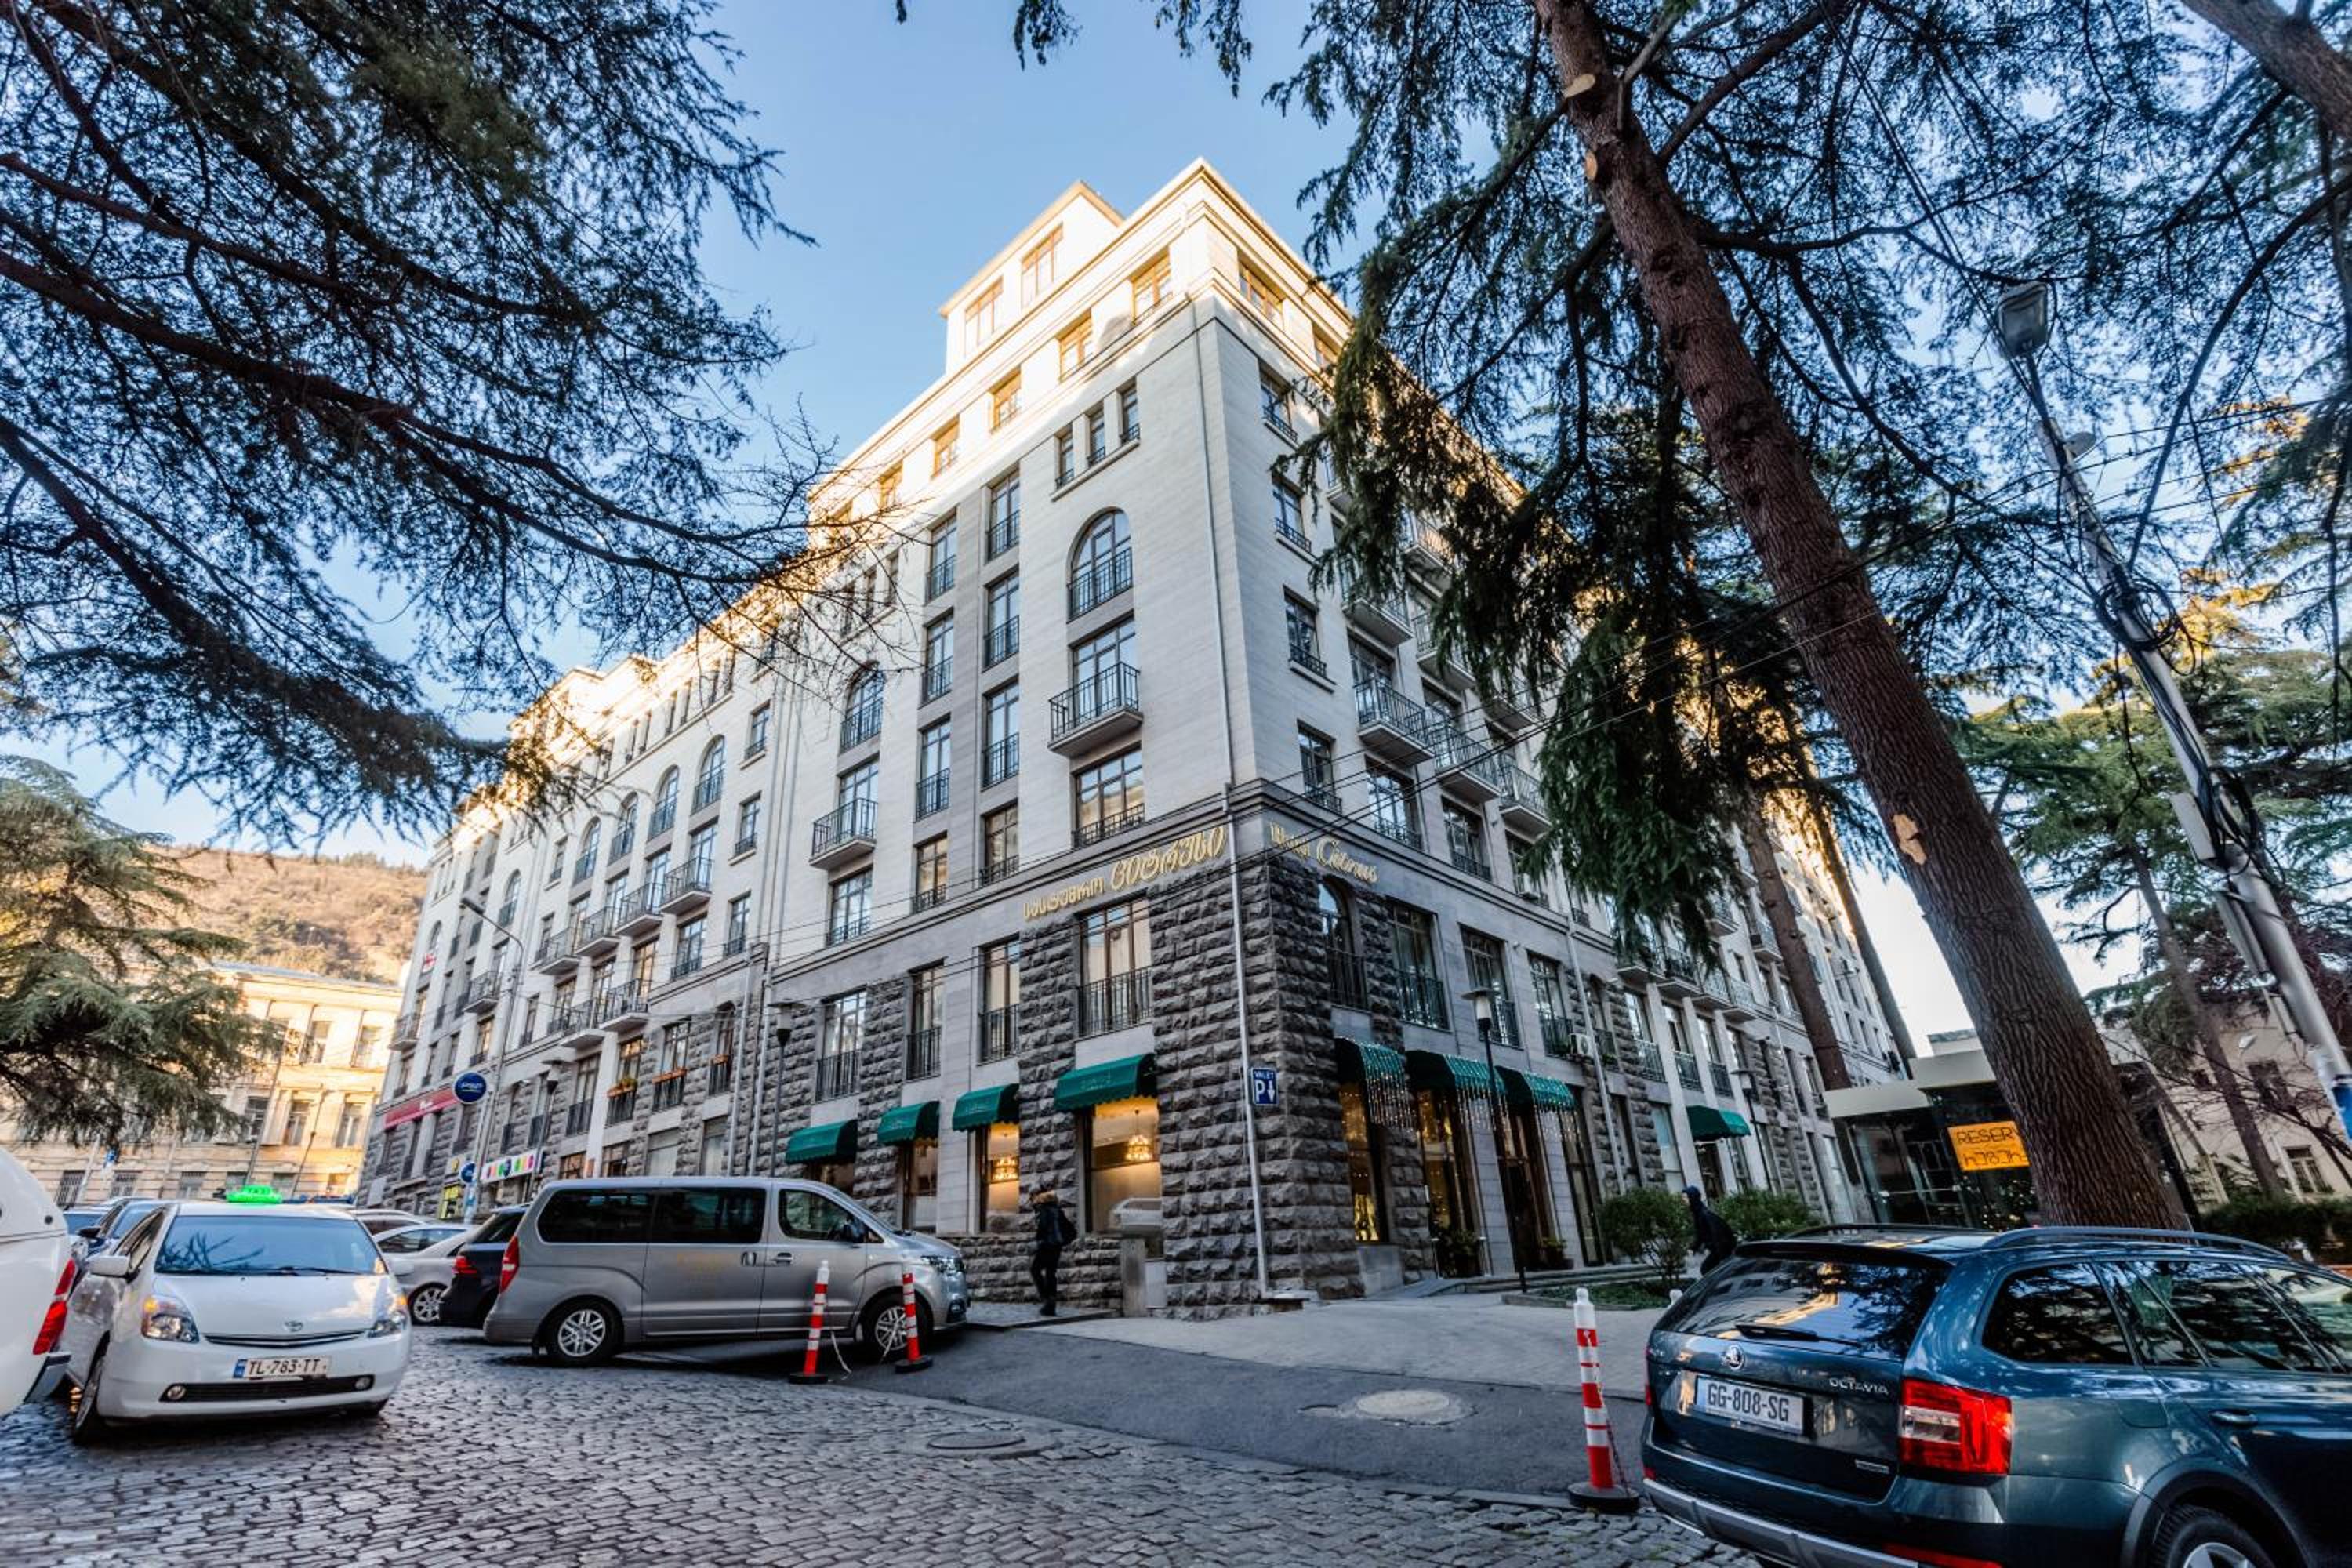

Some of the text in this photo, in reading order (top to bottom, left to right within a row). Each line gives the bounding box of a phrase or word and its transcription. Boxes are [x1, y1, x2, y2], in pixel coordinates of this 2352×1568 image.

[1255, 1079, 1266, 1103] P
[1829, 1377, 1889, 1396] OCTAVIA
[1707, 1382, 1790, 1423] GG-808-SG
